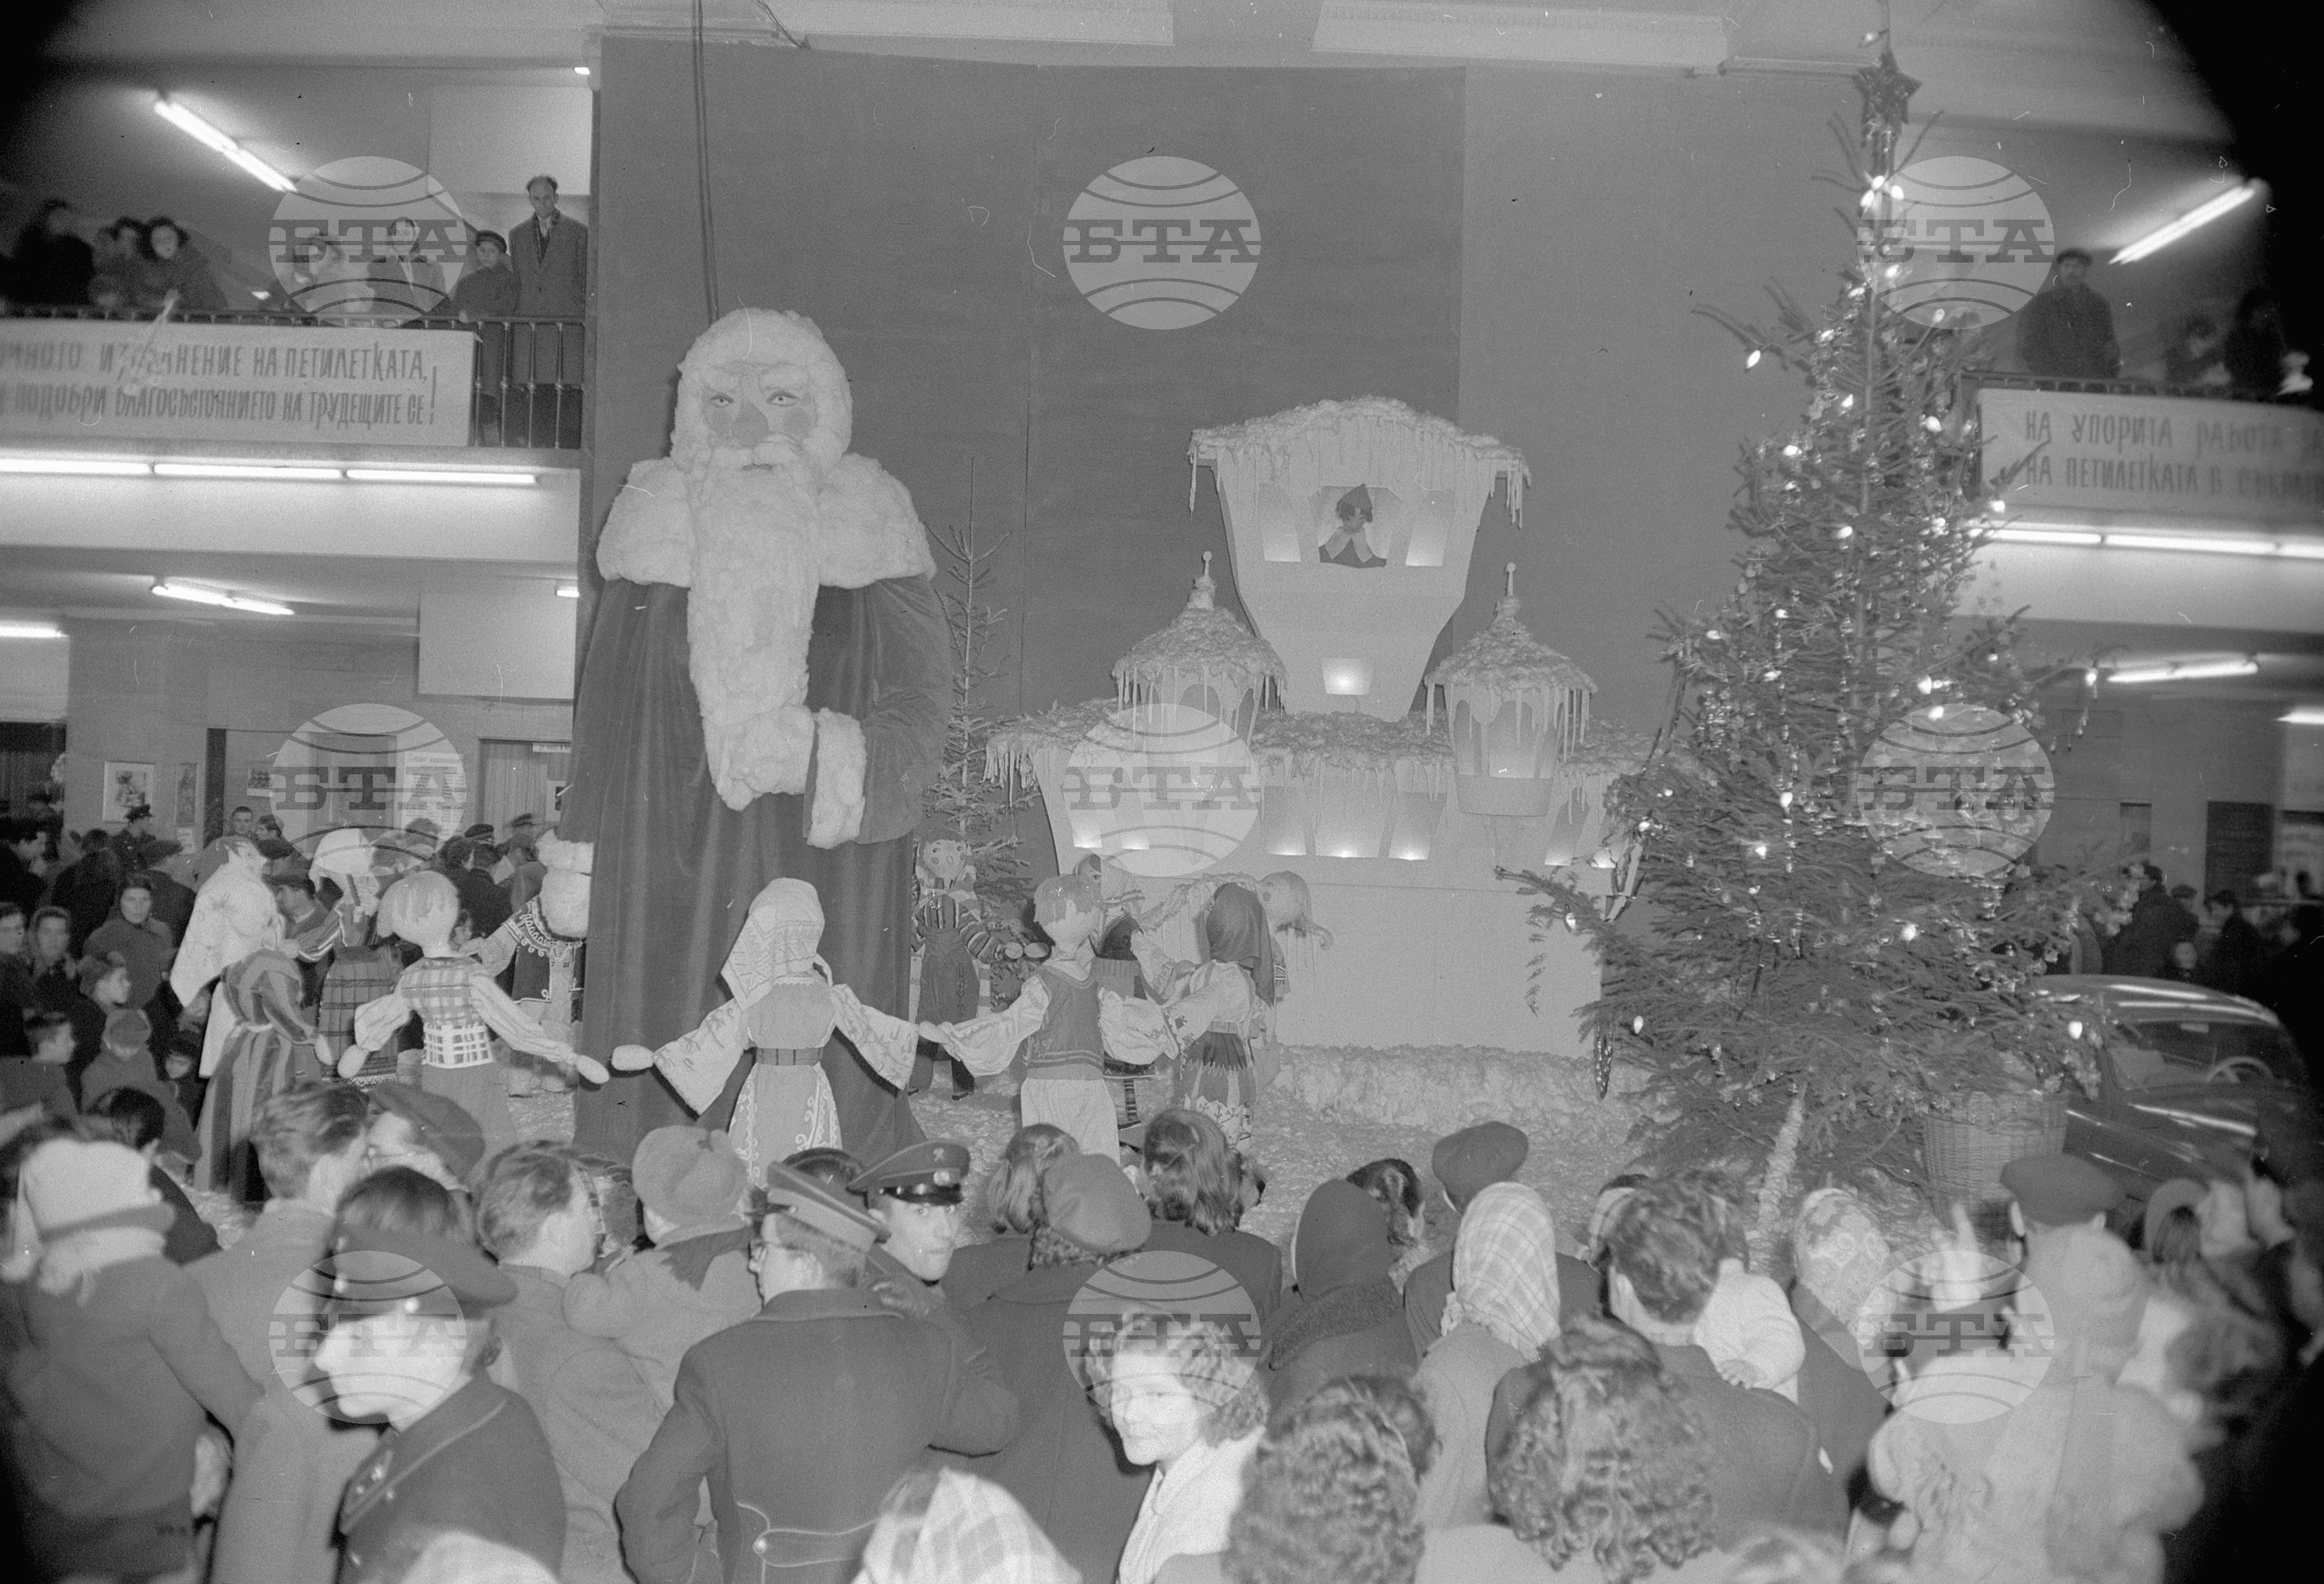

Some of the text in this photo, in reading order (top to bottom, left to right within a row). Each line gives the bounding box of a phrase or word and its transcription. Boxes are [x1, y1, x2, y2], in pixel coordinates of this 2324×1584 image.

[253, 346, 277, 377] НА
[284, 340, 428, 384] ПЕТИЛЕТКАТА,
[283, 392, 302, 422] НА
[309, 391, 401, 431] ТРУДЕЩИТЕ
[2026, 410, 2052, 441] НА
[2071, 413, 2173, 454] УПОРИТА
[2026, 455, 2053, 486] НА
[2066, 454, 2199, 494] ПЕТИЛЕТКАТА
